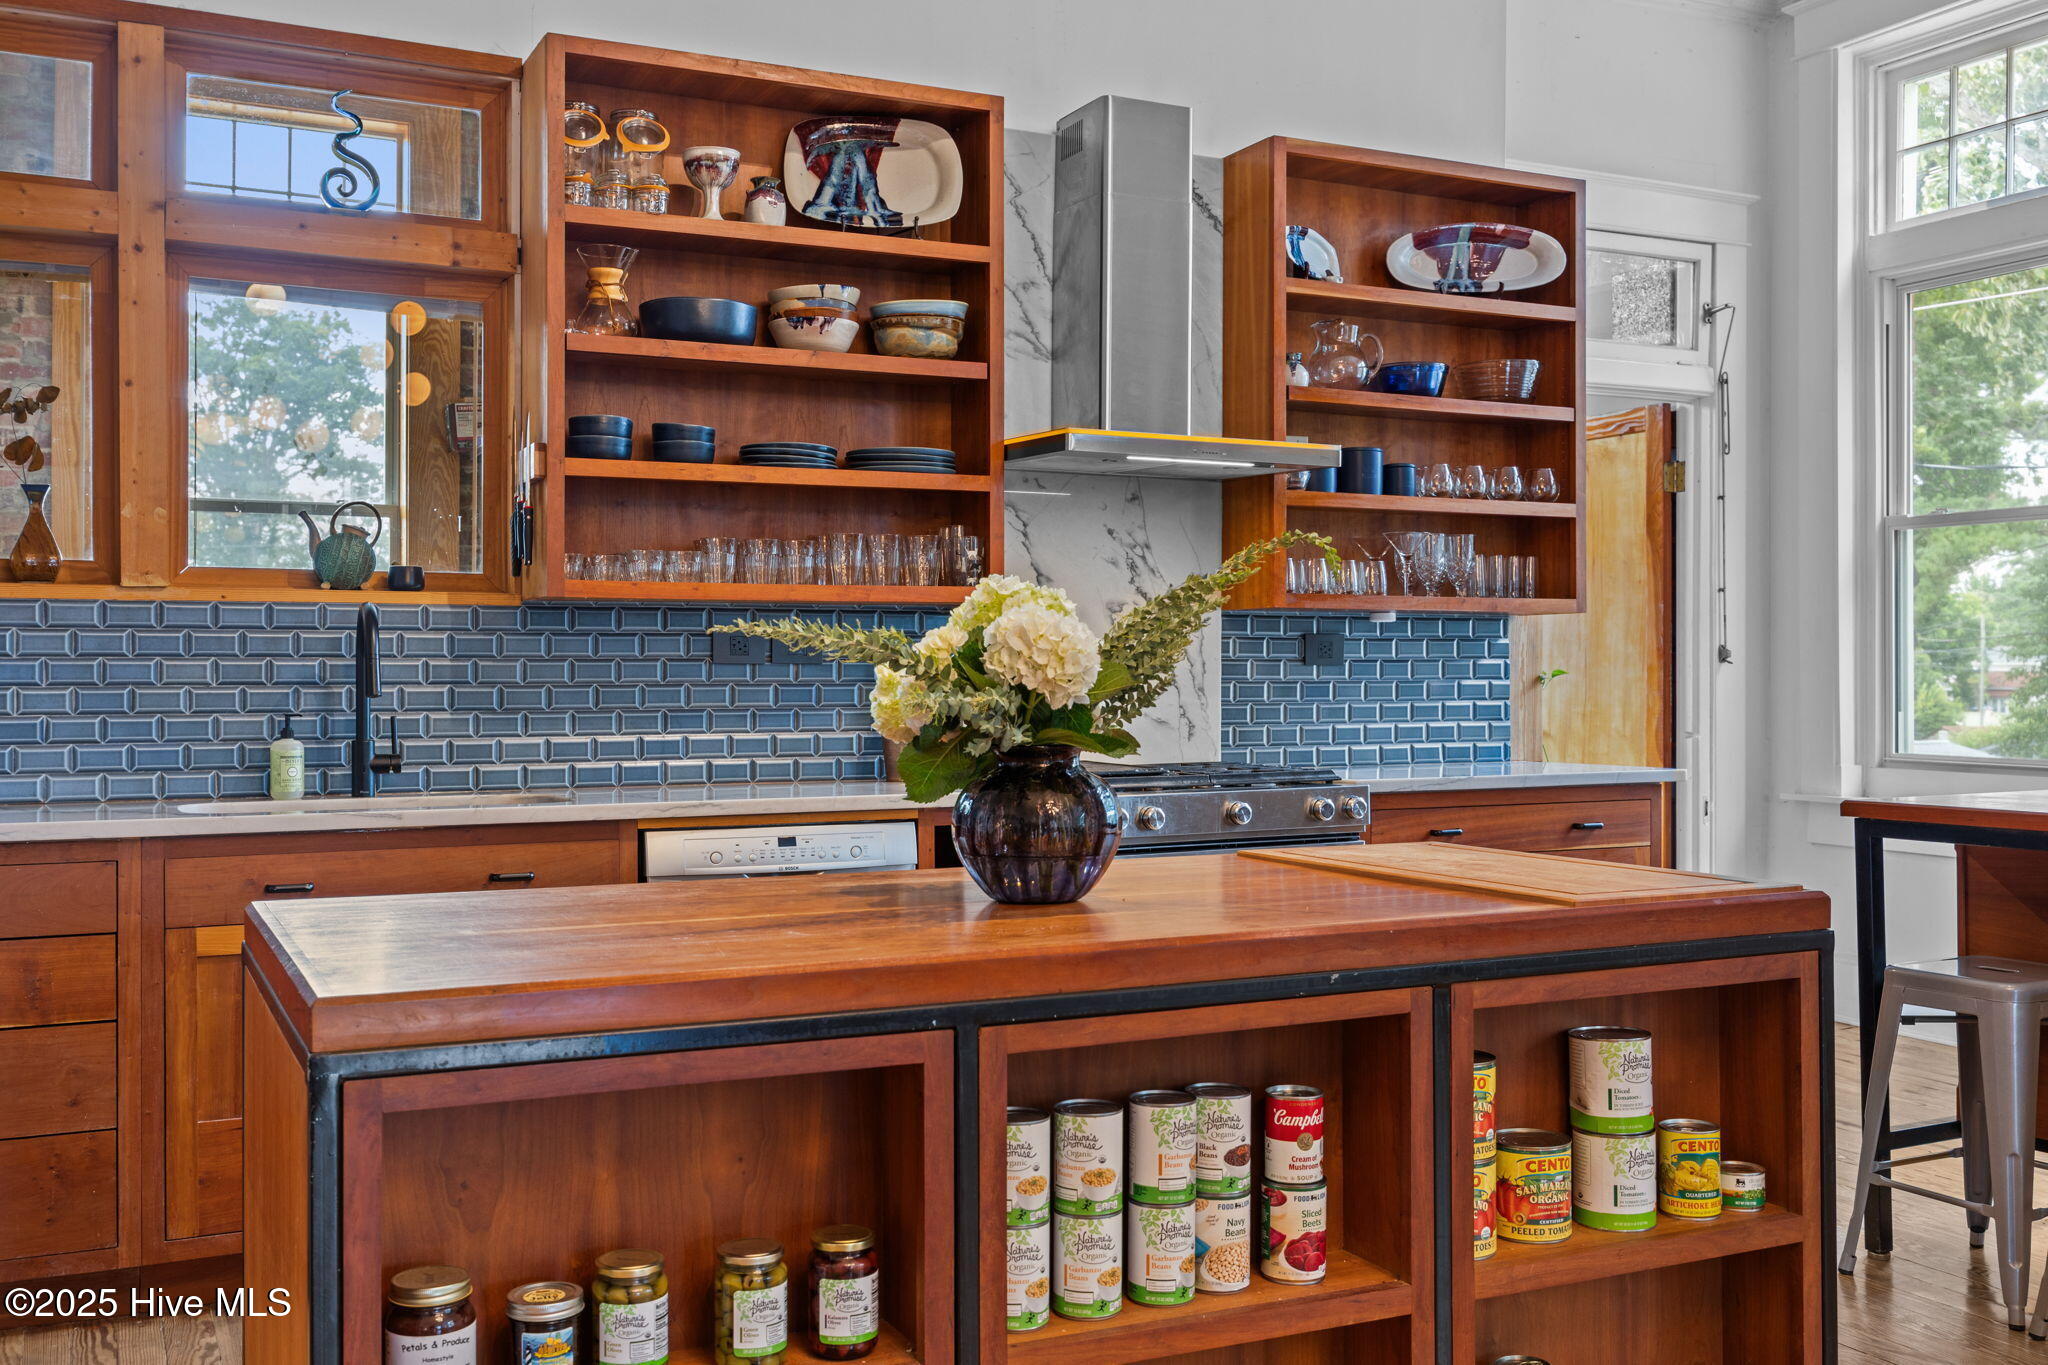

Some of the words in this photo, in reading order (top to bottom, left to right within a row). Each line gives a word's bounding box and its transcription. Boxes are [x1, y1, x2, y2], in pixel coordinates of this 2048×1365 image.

[1207, 1111, 1242, 1124] Nature's
[1205, 1119, 1244, 1132] Promise
[1062, 1128, 1099, 1142] Nature's
[1211, 1131, 1236, 1139] Organic
[1007, 1141, 1034, 1151] ture's
[1062, 1139, 1103, 1151] Promise
[1199, 1143, 1216, 1151] Black
[1678, 1140, 1720, 1152] CENTO
[1066, 1149, 1093, 1159] Organic
[1199, 1151, 1218, 1159] Beans
[1291, 1155, 1314, 1163] Cream
[1007, 1159, 1028, 1169] rganic
[1289, 1163, 1319, 1171] Mushroom
[1525, 1157, 1570, 1173] CENTO
[1516, 1185, 1537, 1197] SAN
[1530, 1191, 1569, 1204] ORGANIC
[1217, 1203, 1234, 1211] FOOD
[1667, 1199, 1708, 1210] ARTICHOKE
[1301, 1208, 1322, 1219] Sliced
[1160, 1220, 1192, 1234] Nature's
[1226, 1218, 1246, 1228] Navy
[1302, 1219, 1322, 1228] Beets
[1225, 1227, 1247, 1238] Beans
[1511, 1226, 1546, 1237] PEELED
[1077, 1230, 1113, 1245] Nature's
[1157, 1231, 1194, 1245] Promise
[1074, 1241, 1116, 1255] Promise
[1164, 1240, 1188, 1251] Organic
[1081, 1252, 1106, 1261] Organic
[1008, 1262, 1035, 1273] Organic
[1068, 1265, 1102, 1273] Garbanzo
[1151, 1262, 1171, 1270] Beans
[1069, 1273, 1089, 1281] Beans
[835, 1288, 865, 1298] Nature's
[751, 1298, 780, 1309] Nature's
[834, 1295, 867, 1306] Promise
[750, 1304, 781, 1317] Promise
[615, 1312, 647, 1324] Nature's
[612, 1321, 649, 1332] Promise
[401, 1342, 428, 1352] Petals
[432, 1340, 438, 1349] &
[442, 1336, 471, 1347] Produce
[422, 1354, 455, 1363] Homestyle
